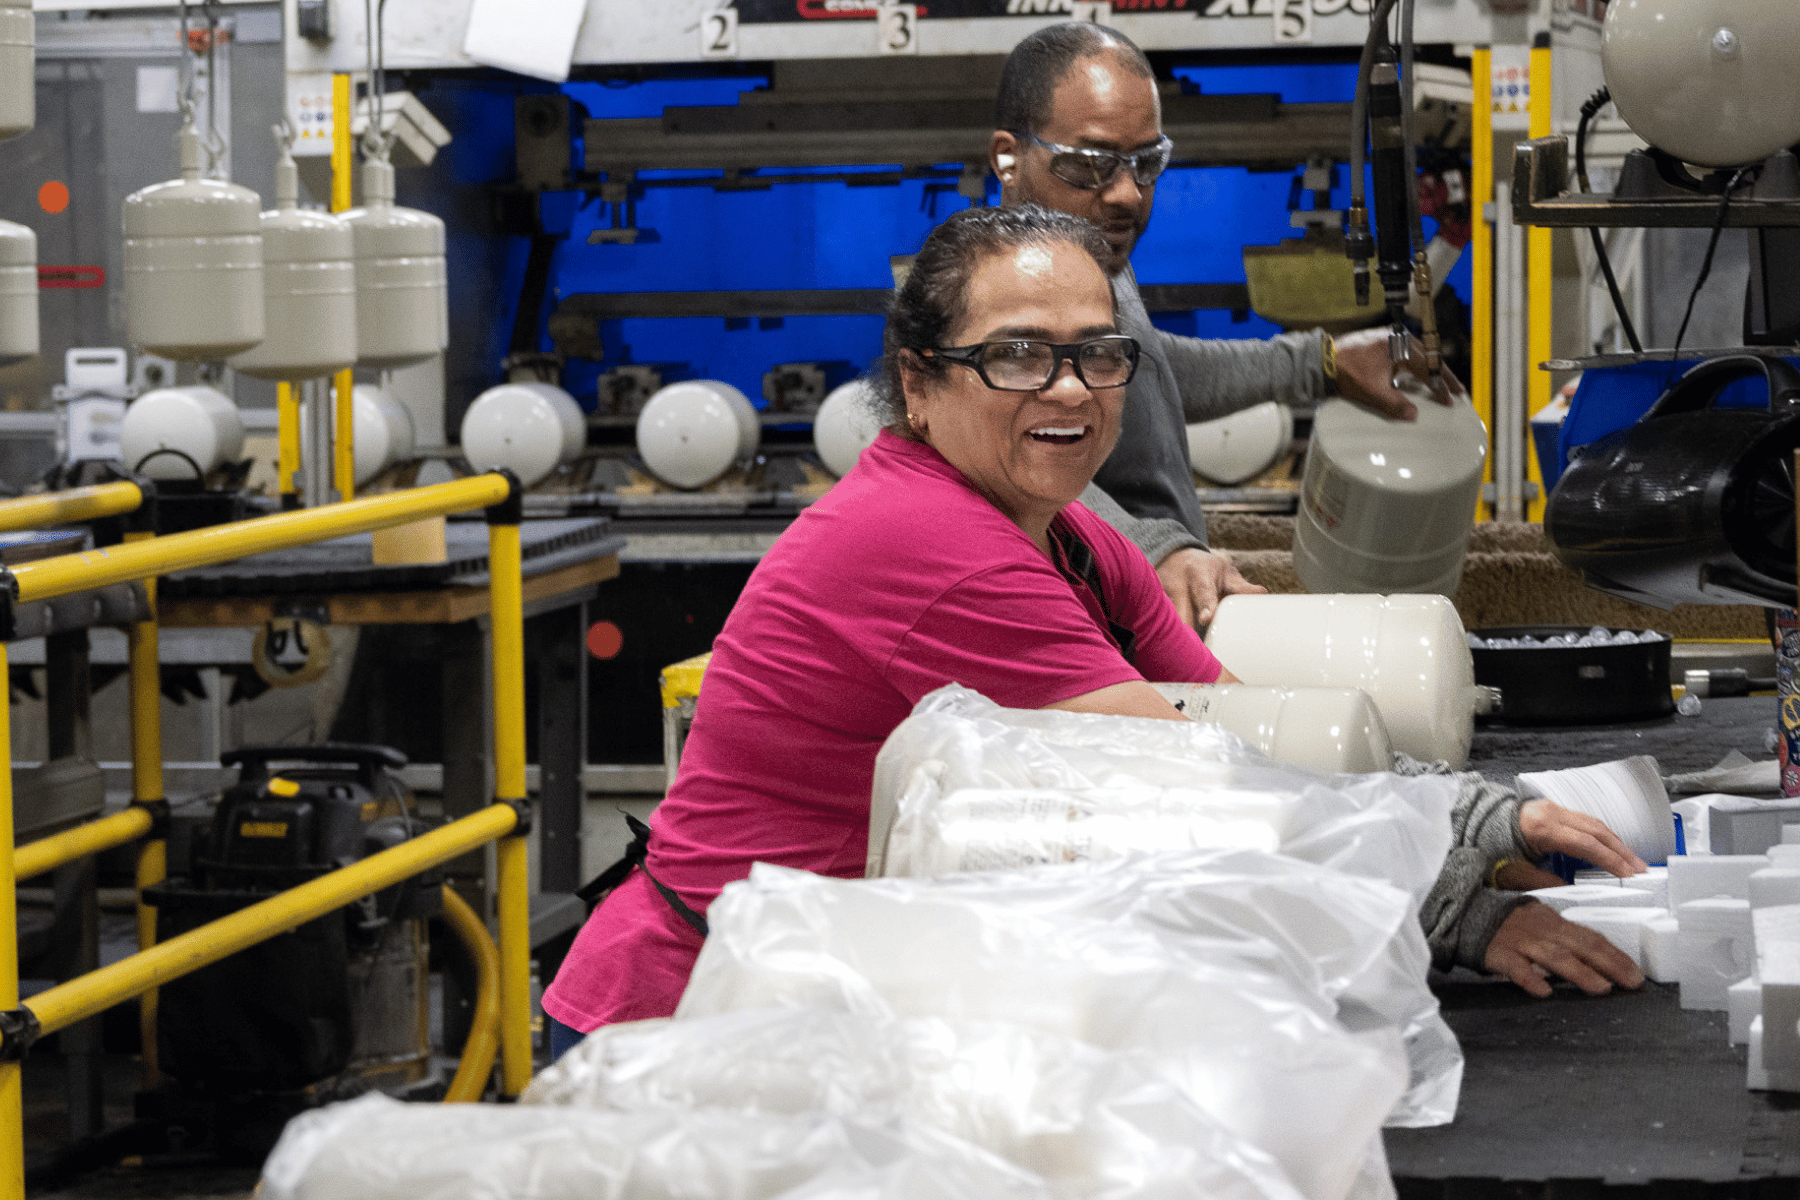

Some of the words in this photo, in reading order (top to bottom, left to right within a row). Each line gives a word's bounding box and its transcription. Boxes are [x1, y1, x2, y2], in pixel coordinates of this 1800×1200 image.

[710, 14, 730, 51] 2
[889, 11, 911, 50] 3
[1281, 0, 1306, 39] 5
